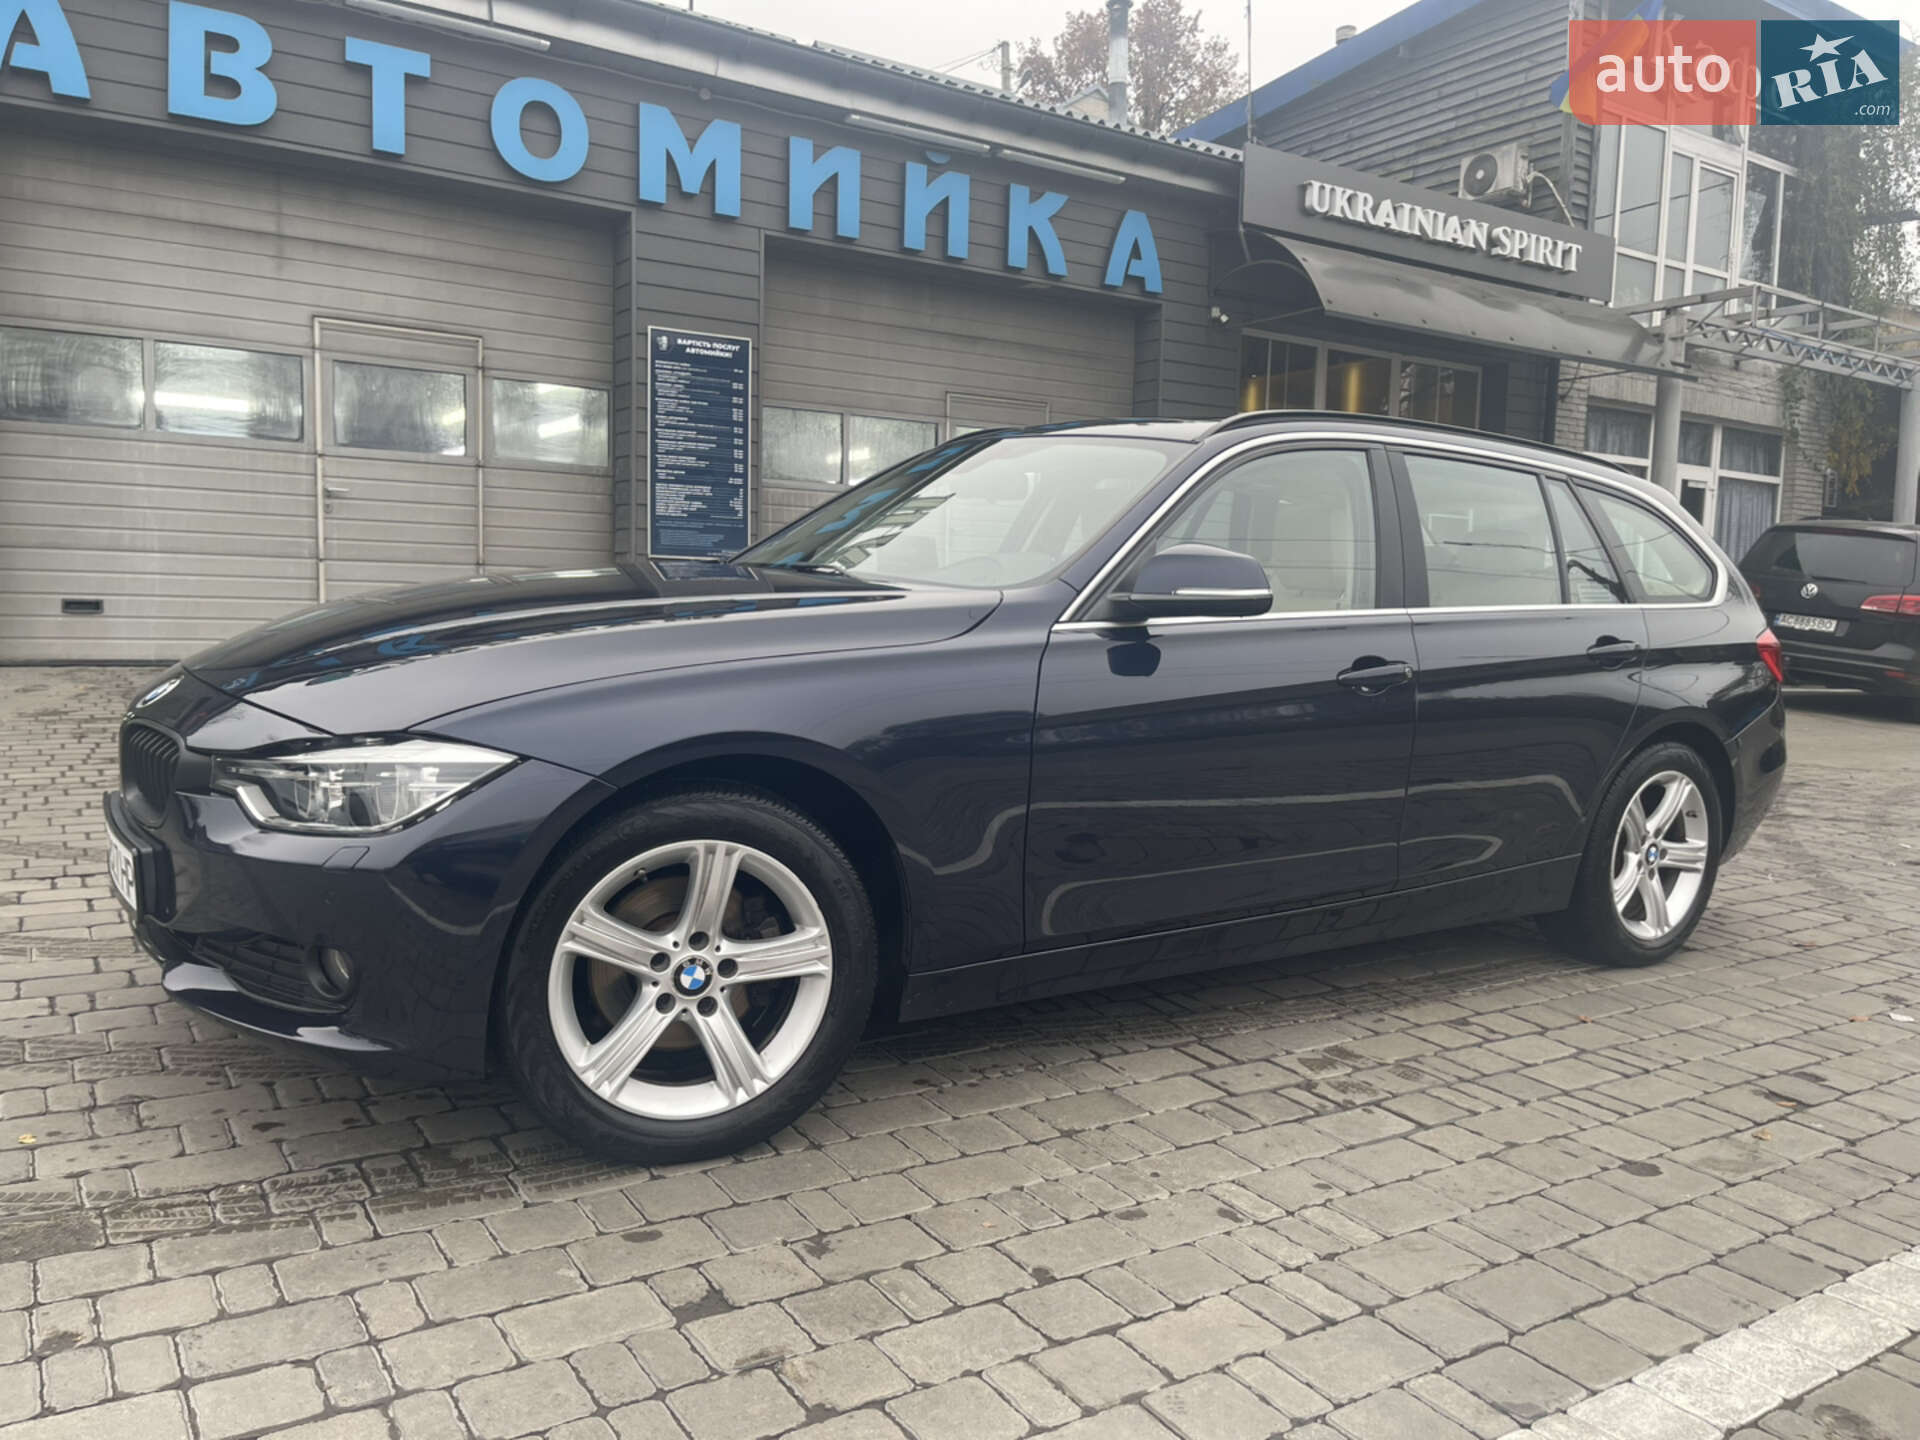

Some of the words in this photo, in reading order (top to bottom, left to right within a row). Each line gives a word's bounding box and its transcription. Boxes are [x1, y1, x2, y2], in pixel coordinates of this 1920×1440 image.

[0, 0, 1163, 294] АВТОМИЙКА
[1304, 180, 1489, 251] UKRAINIAN
[1491, 226, 1582, 272] SPIRIT
